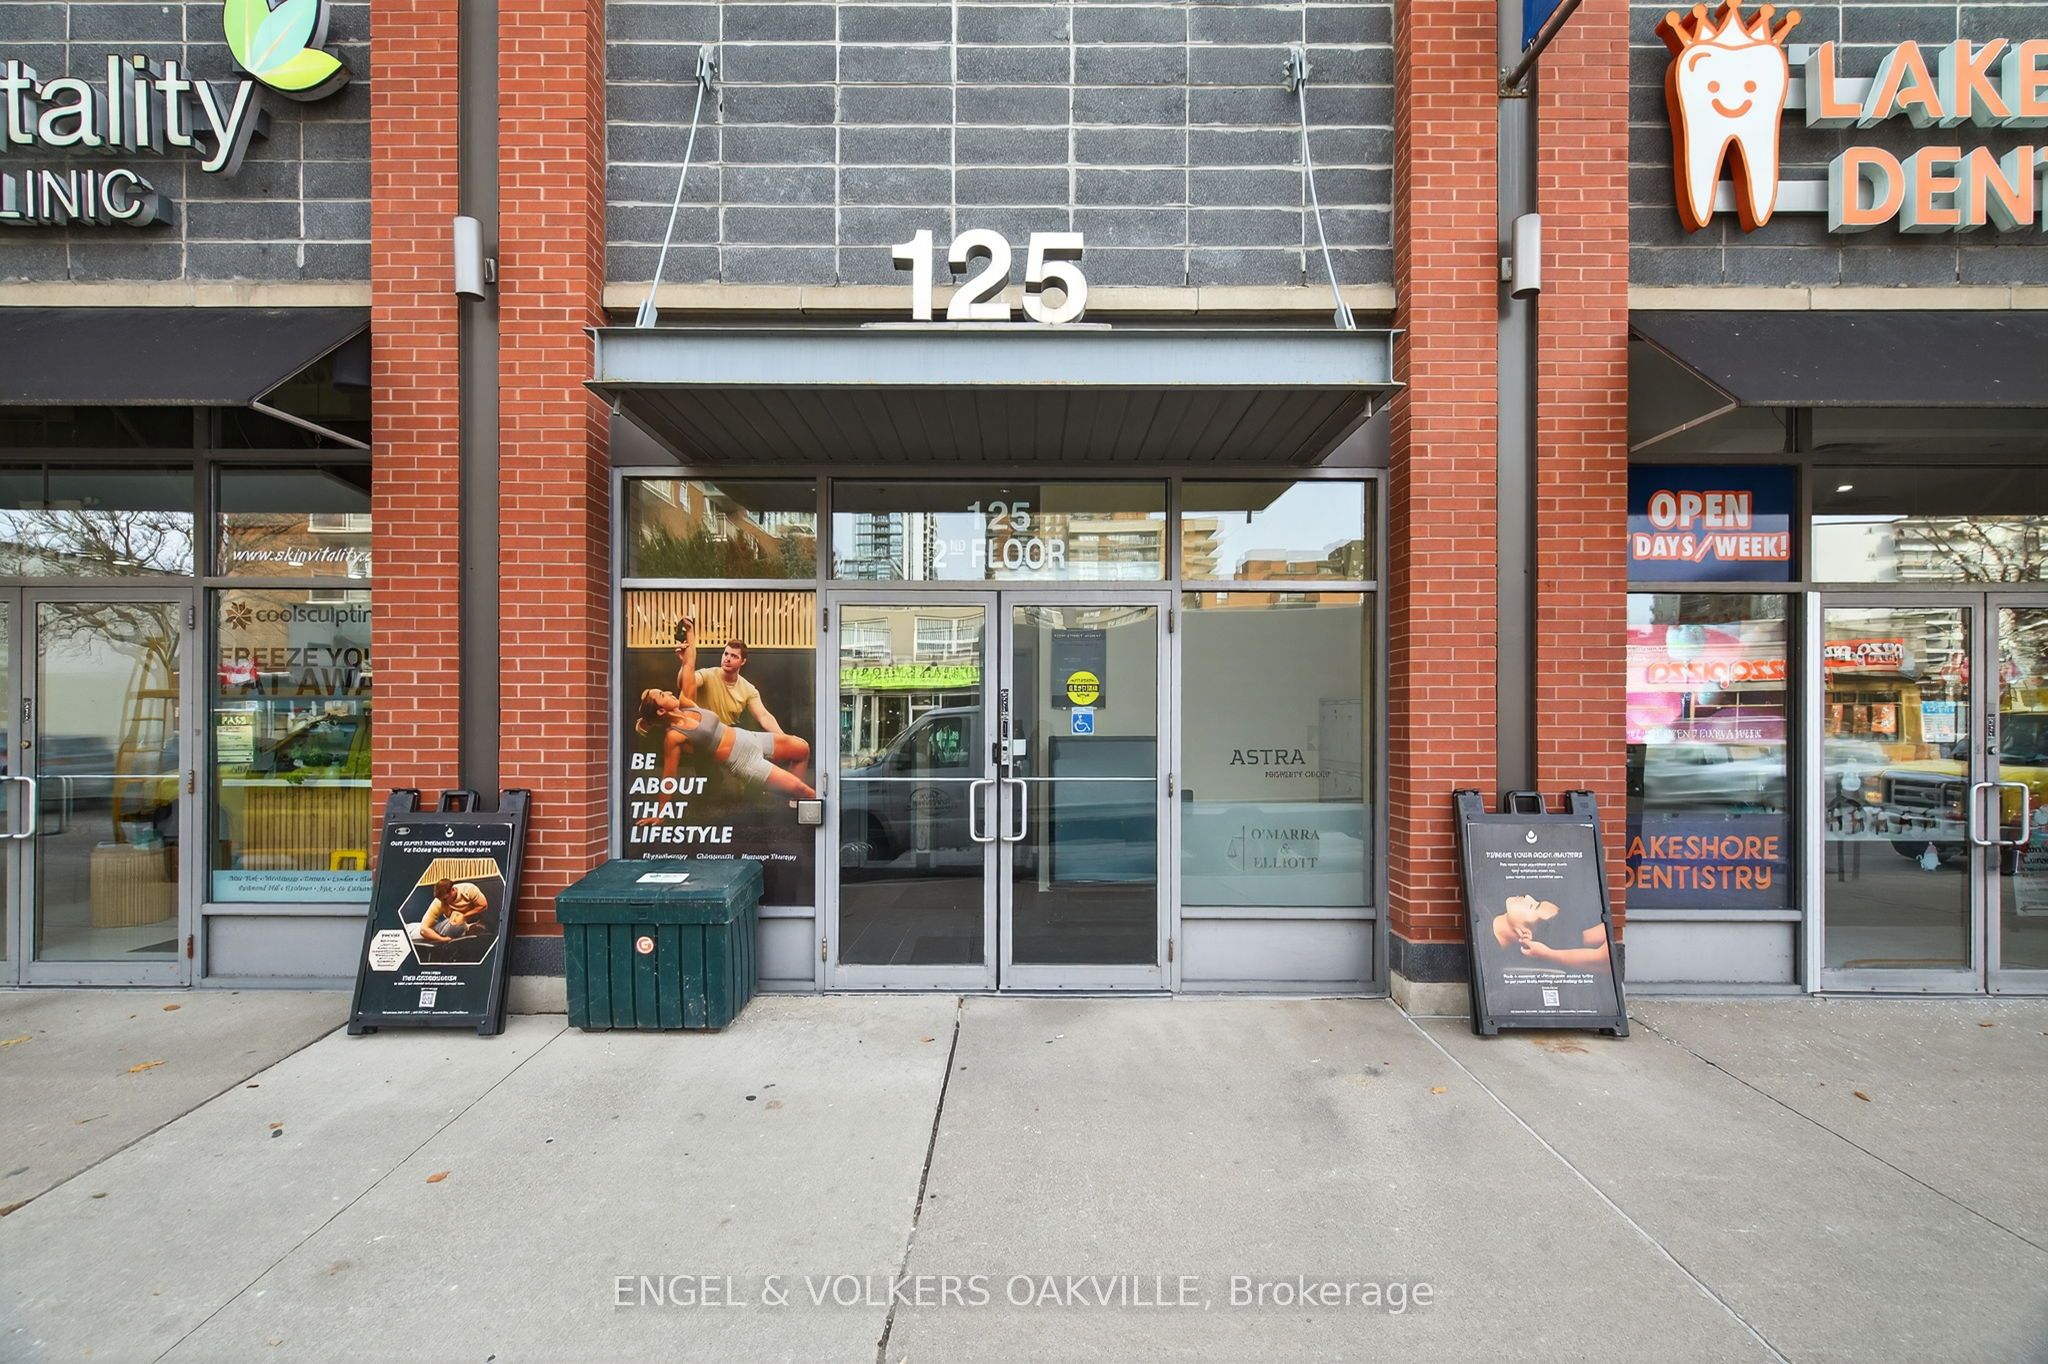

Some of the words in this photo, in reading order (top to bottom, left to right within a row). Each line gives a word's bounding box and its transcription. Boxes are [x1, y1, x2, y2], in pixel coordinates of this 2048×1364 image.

[1840, 145, 2048, 226] DEN
[891, 228, 1089, 323] 125
[966, 501, 1032, 532] 125
[1650, 491, 1750, 529] OPEN
[971, 538, 1066, 570] FLOOR
[220, 670, 288, 696] AT
[630, 752, 657, 770] BE
[1229, 748, 1307, 766] ASTRA
[629, 776, 708, 796] ABOUT
[631, 801, 688, 819] THAT
[630, 826, 734, 845] LIFESTYLE
[1627, 835, 1780, 860] AKESHORE
[1253, 856, 1319, 869] ELLIOTT
